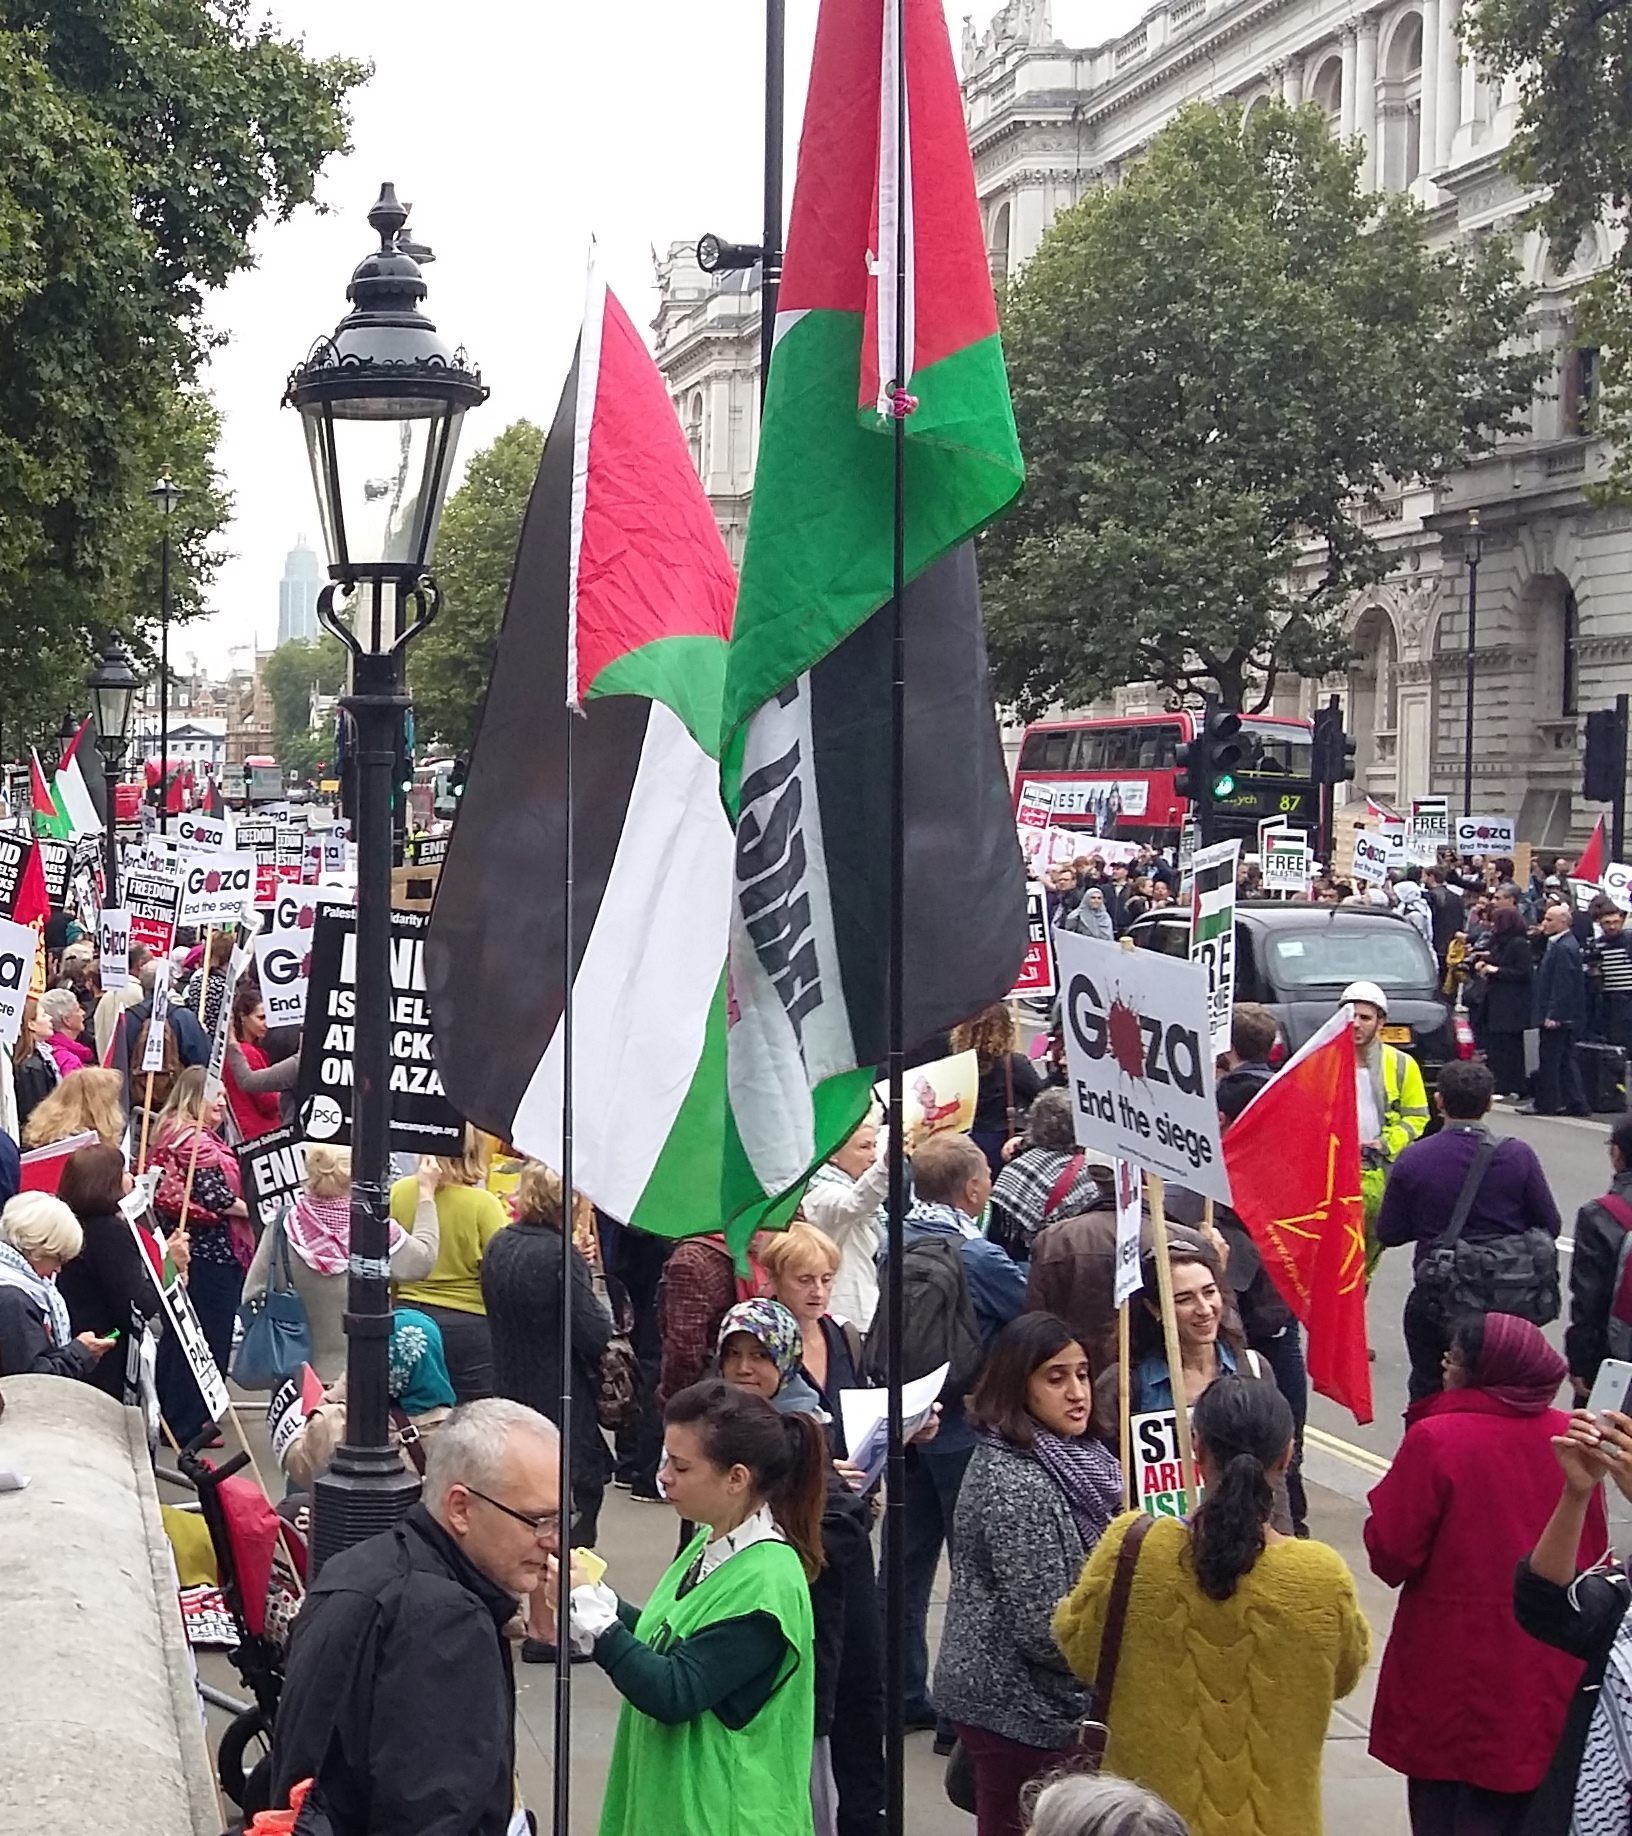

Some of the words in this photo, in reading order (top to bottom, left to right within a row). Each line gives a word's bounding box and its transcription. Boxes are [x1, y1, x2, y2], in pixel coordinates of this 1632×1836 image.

[1279, 795, 1301, 811] 87
[179, 821, 224, 846] Gza
[237, 827, 276, 844] FREEDOM
[1413, 818, 1446, 830] FREE
[1459, 824, 1511, 840] Gza
[277, 834, 302, 848] EEDOM
[1357, 838, 1386, 864] Gza
[1477, 842, 1489, 850] the
[45, 862, 67, 875] AEL'S
[148, 850, 165, 873] Gza
[277, 853, 302, 866] ESTINE
[1266, 854, 1305, 871] FREE
[128, 878, 176, 901] FREEDOM
[187, 867, 251, 895] Gza
[184, 903, 201, 916] End
[202, 901, 217, 912] the
[219, 900, 241, 914] sieg
[321, 905, 356, 921] Palest
[390, 912, 423, 928] idarity
[102, 923, 126, 956] Gza
[269, 994, 301, 1012] End
[322, 1024, 435, 1060] ATCK
[1068, 973, 1206, 1099] Gza
[390, 1065, 446, 1097] AZA
[313, 1109, 340, 1125] PSC
[1076, 1079, 1116, 1124] End
[1117, 1094, 1151, 1138] the
[1155, 1111, 1212, 1169] siege
[268, 1378, 298, 1426] YCOTT
[1139, 1418, 1180, 1465] ST
